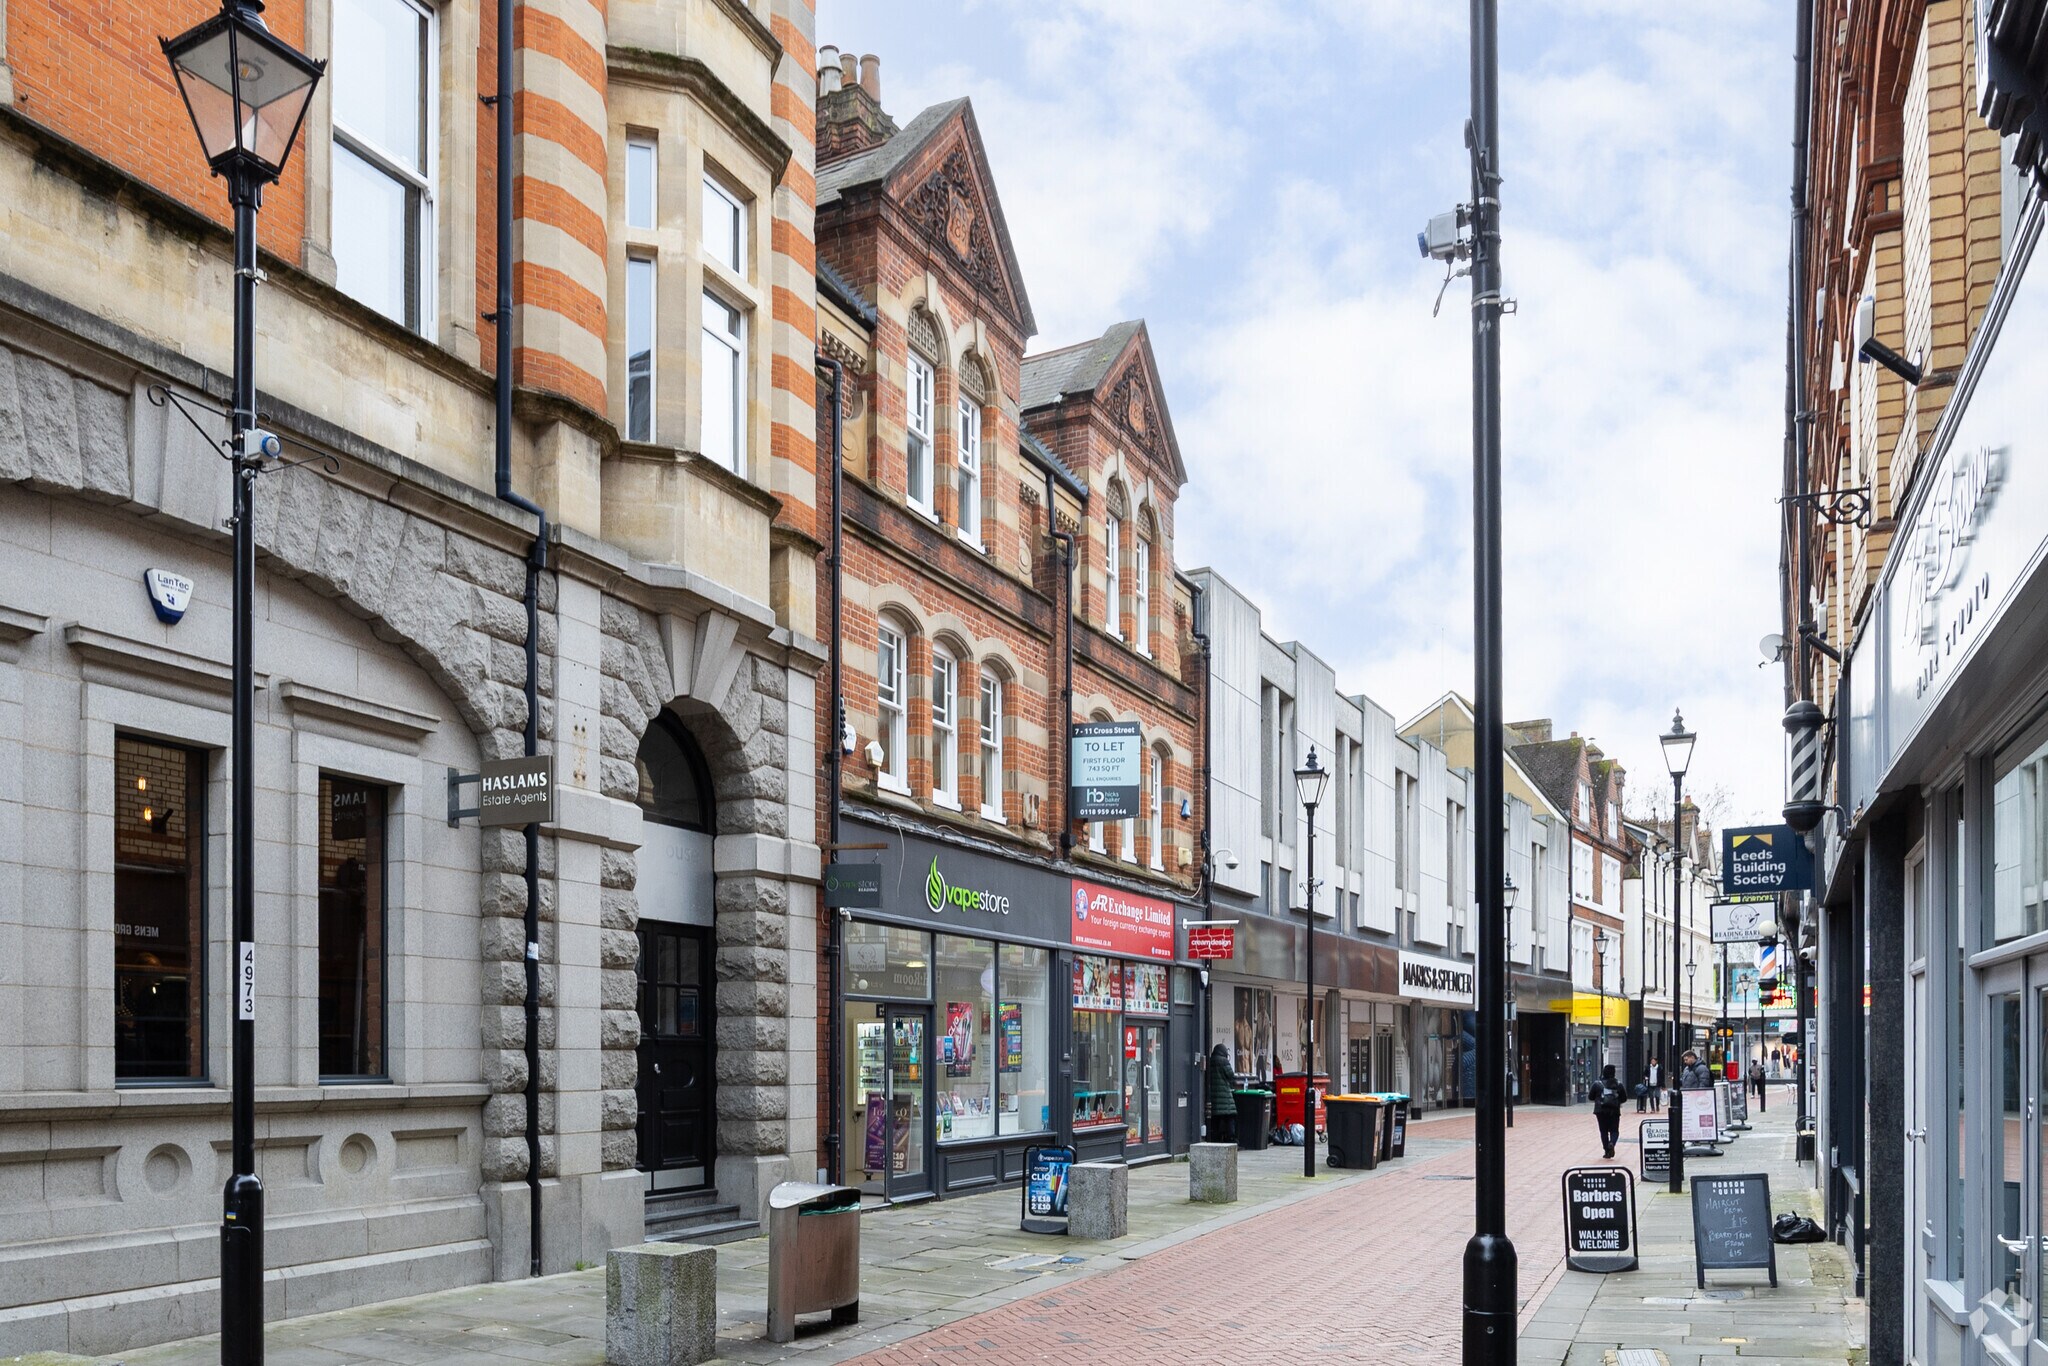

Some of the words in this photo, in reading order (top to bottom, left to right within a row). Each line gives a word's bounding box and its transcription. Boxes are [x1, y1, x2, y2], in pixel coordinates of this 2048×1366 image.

[157, 573, 189, 591] LanTec
[1945, 572, 1989, 656] STUDIO
[1114, 726, 1135, 734] Street
[1085, 742, 1099, 752] TO
[1104, 741, 1125, 751] LET
[482, 771, 547, 791] HASLAMS
[482, 793, 511, 806] Estate
[513, 790, 547, 805] Agents
[1733, 849, 1773, 861] Leeds
[1733, 861, 1786, 874] Building
[1733, 873, 1784, 886] Society
[945, 884, 1010, 915] vapestore
[1109, 897, 1143, 923] Exchange
[1145, 905, 1171, 926] Limited
[1091, 915, 1102, 925] Your
[1102, 916, 1119, 930] foreign
[1120, 921, 1138, 934] currency
[1138, 926, 1158, 938] exchange
[1158, 930, 1171, 939] expert
[1714, 929, 1743, 938] READING
[244, 949, 254, 1013] 4973
[1031, 1173, 1051, 1181] CLIQ
[1573, 1189, 1622, 1203] Barbers
[1705, 1198, 1741, 1210] HAIRCUT
[1582, 1206, 1615, 1220] Open
[1724, 1207, 1744, 1215] FROM
[1579, 1230, 1619, 1239] WALK-INS
[1709, 1230, 1732, 1242] BEARD
[1734, 1230, 1752, 1239] TRIM
[1579, 1240, 1620, 1249] WELCOME
[1724, 1240, 1745, 1248] FROM
